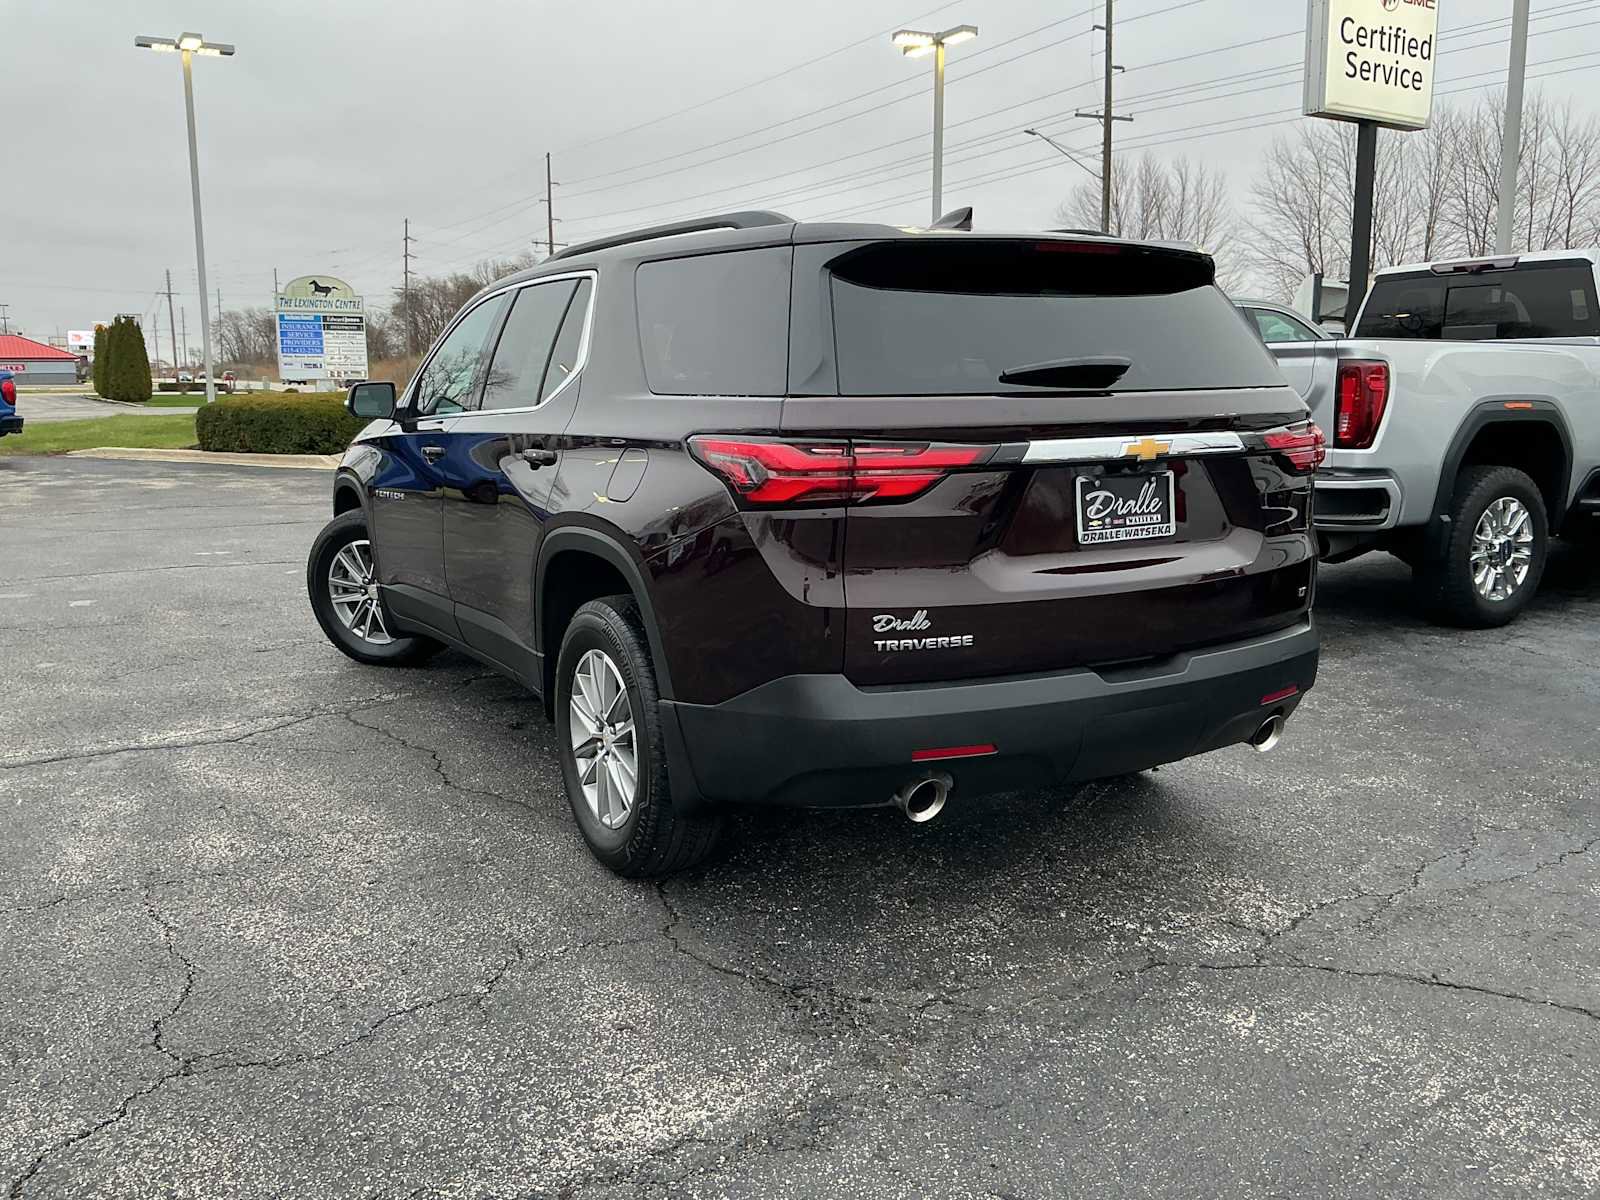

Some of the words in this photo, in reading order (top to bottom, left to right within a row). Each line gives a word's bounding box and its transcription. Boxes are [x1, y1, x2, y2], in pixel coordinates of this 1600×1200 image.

[1340, 16, 1433, 61] Certified
[1345, 51, 1423, 91] Service
[280, 297, 292, 308] THE
[294, 298, 334, 310] LEXINGTON
[335, 299, 361, 310] CENTRE
[1085, 481, 1162, 519] Dralle
[1082, 530, 1121, 542] DRALLE
[1124, 525, 1171, 537] WATSEKA
[872, 609, 931, 633] Dralle
[873, 635, 974, 652] TRAVERSE
